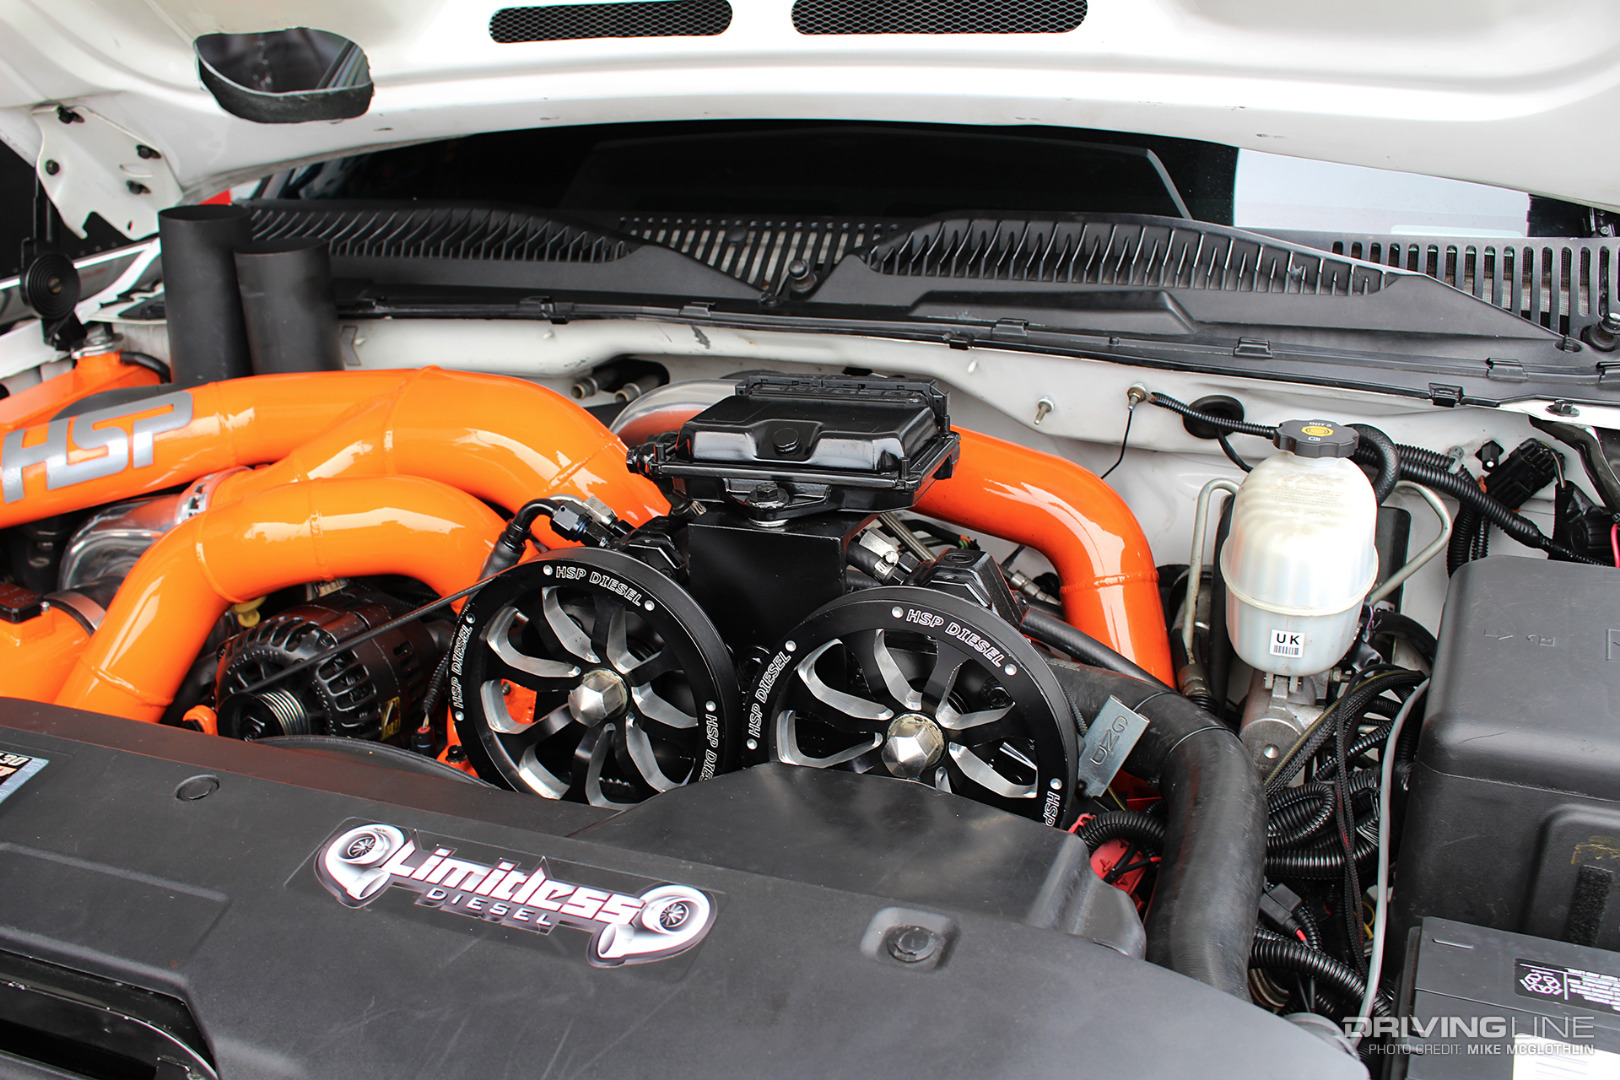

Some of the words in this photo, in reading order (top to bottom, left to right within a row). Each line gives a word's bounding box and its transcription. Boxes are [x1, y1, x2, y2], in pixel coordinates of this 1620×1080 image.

[1, 391, 193, 504] HSP
[556, 566, 586, 580] HSP
[589, 572, 642, 607] DIESEL
[451, 624, 474, 675] DIESEL
[906, 609, 944, 628] HSP
[945, 622, 1004, 668] DIESEL
[451, 677, 465, 709] HSP
[755, 650, 791, 705] DIESEL
[705, 714, 719, 748] HSP
[747, 703, 764, 738] HSP
[1090, 716, 1128, 765] GND
[1043, 791, 1060, 827] HSP
[426, 887, 553, 928] DIESEL
